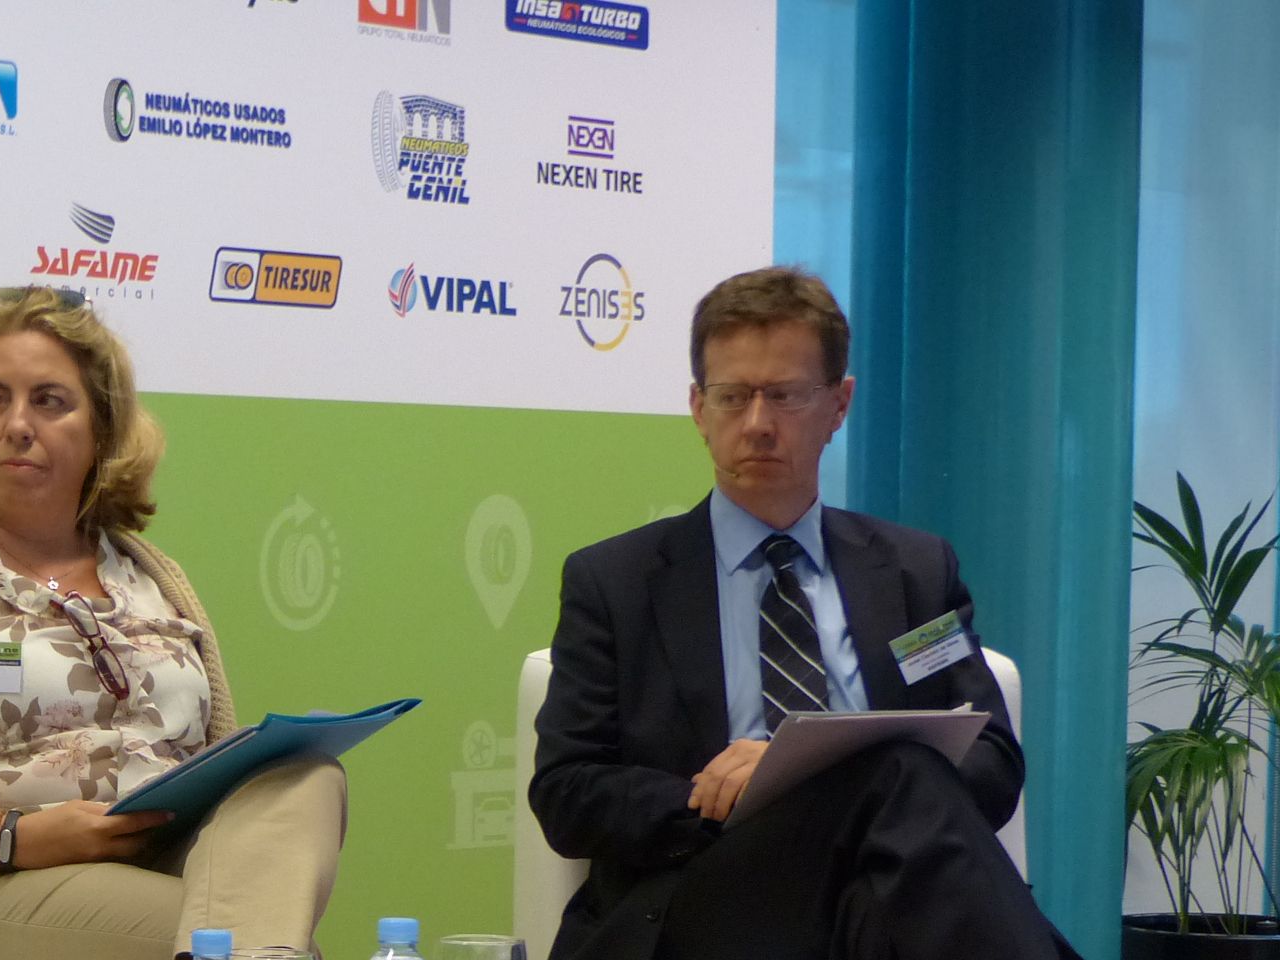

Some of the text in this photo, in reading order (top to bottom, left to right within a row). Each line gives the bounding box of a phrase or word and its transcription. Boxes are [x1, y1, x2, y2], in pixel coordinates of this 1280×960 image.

[580, 4, 642, 31] TURBO
[145, 92, 286, 125] NEUMÁTICOS USADOS
[139, 116, 292, 148] EMILIO LÓPEZ MONTERO
[398, 151, 466, 177] PUENTE
[537, 161, 643, 194] NEXEN TIRE
[30, 246, 159, 285] SAFAME
[263, 266, 333, 293] TIRESUR
[420, 275, 517, 316] VIPAL
